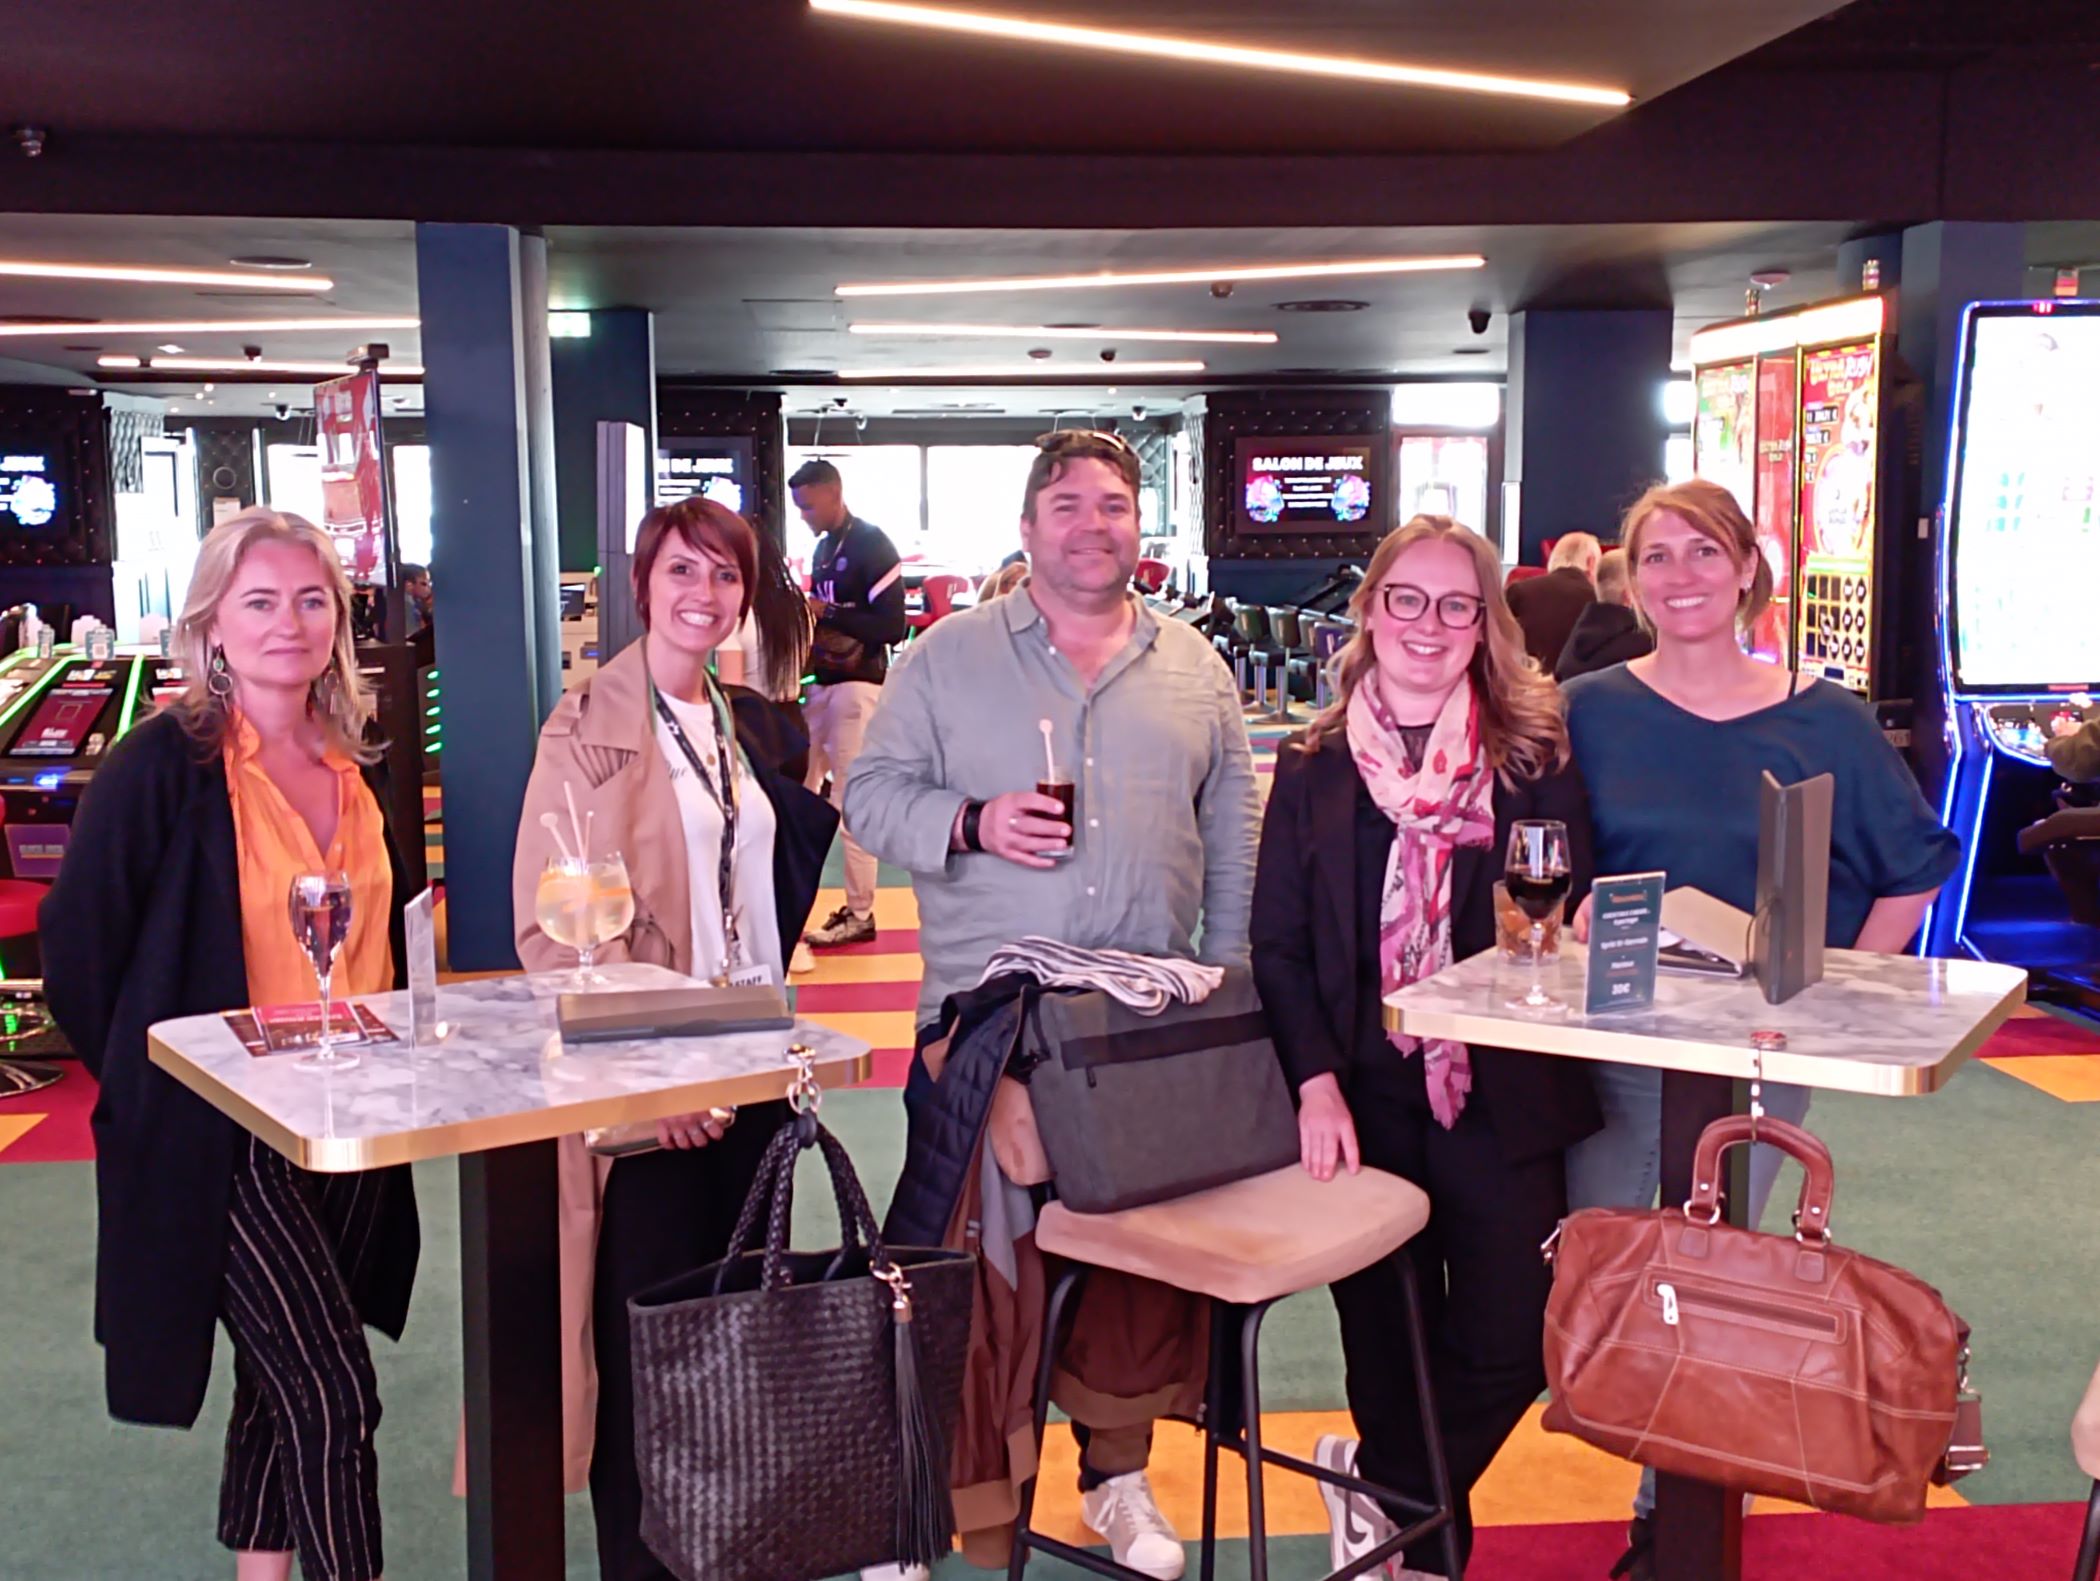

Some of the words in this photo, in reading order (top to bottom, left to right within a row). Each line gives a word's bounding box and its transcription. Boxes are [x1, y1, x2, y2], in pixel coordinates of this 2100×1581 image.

[1252, 457, 1303, 470] SALON
[1305, 456, 1324, 470] DE
[1325, 456, 1363, 470] JEUX
